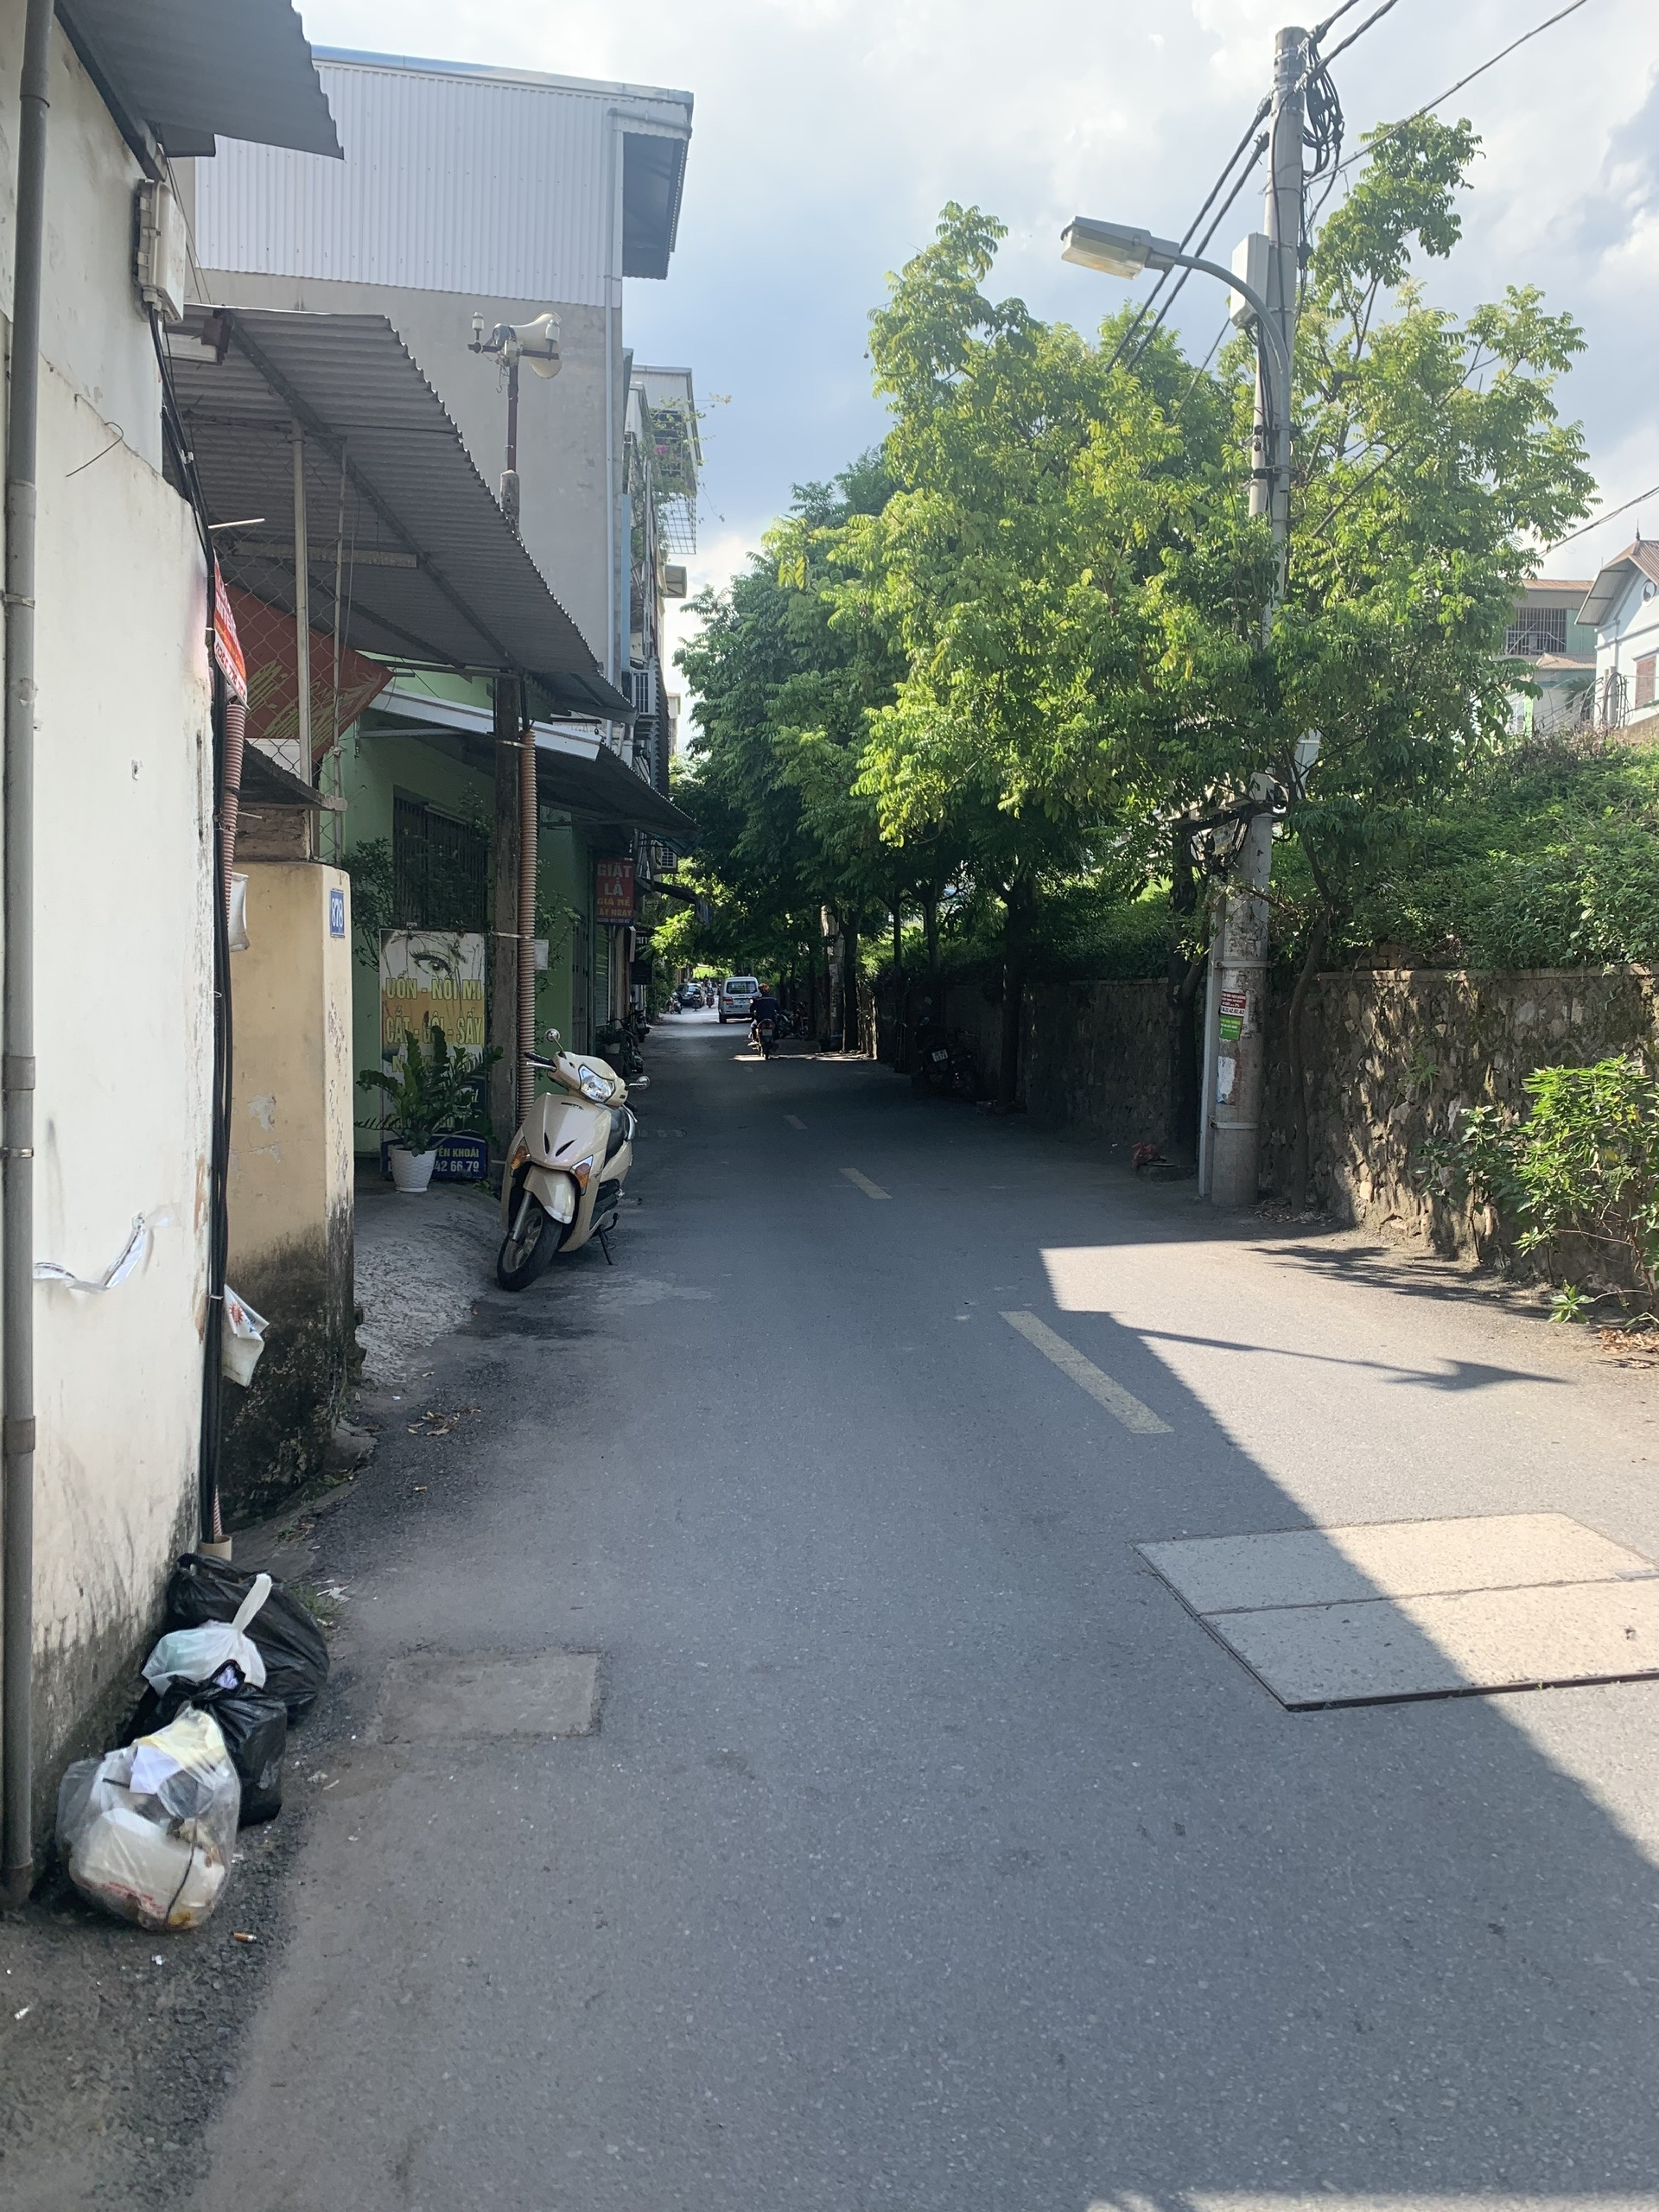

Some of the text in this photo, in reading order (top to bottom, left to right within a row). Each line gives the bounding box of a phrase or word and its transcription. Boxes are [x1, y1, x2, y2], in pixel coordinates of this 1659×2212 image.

[331, 897, 343, 928] 878
[385, 970, 417, 1000] UỐN
[461, 979, 482, 1001] MI
[456, 1007, 483, 1045] SẤY
[453, 1147, 480, 1158] KHOÁI
[466, 1160, 480, 1173] 79
